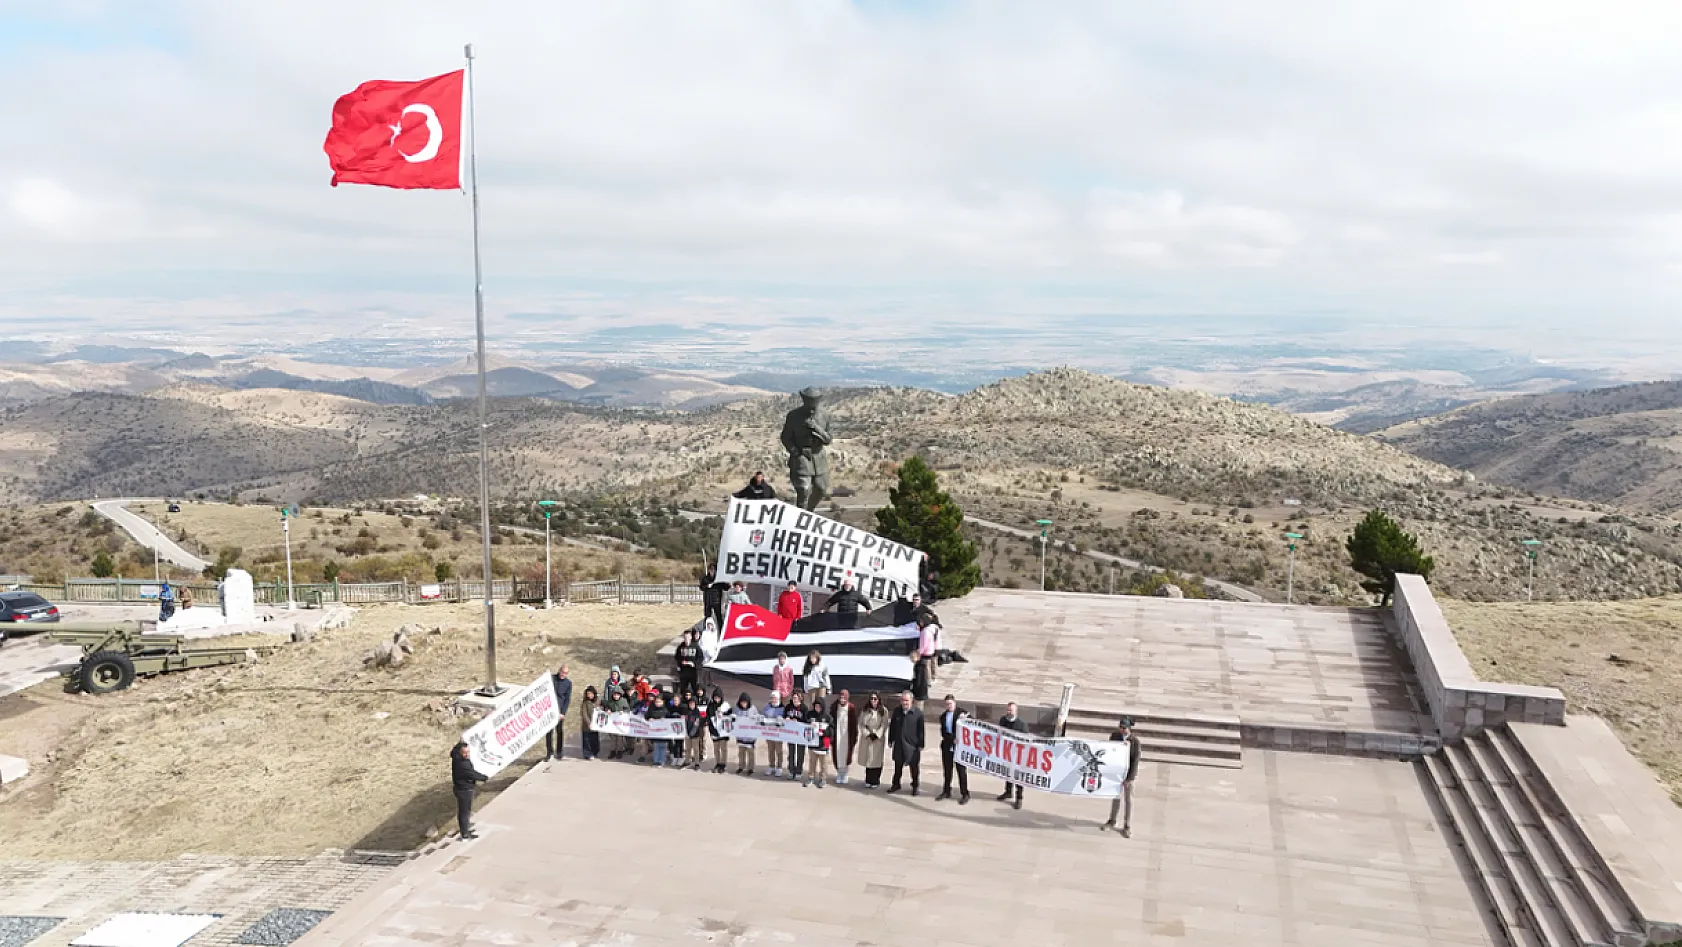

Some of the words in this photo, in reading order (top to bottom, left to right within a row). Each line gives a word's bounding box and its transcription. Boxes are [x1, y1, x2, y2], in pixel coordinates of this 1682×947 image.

[771, 528, 860, 567] HAYATI
[794, 511, 914, 562] OKULDAN
[961, 750, 983, 768] GENEL
[962, 726, 1053, 774] BEŞİKTAŞ
